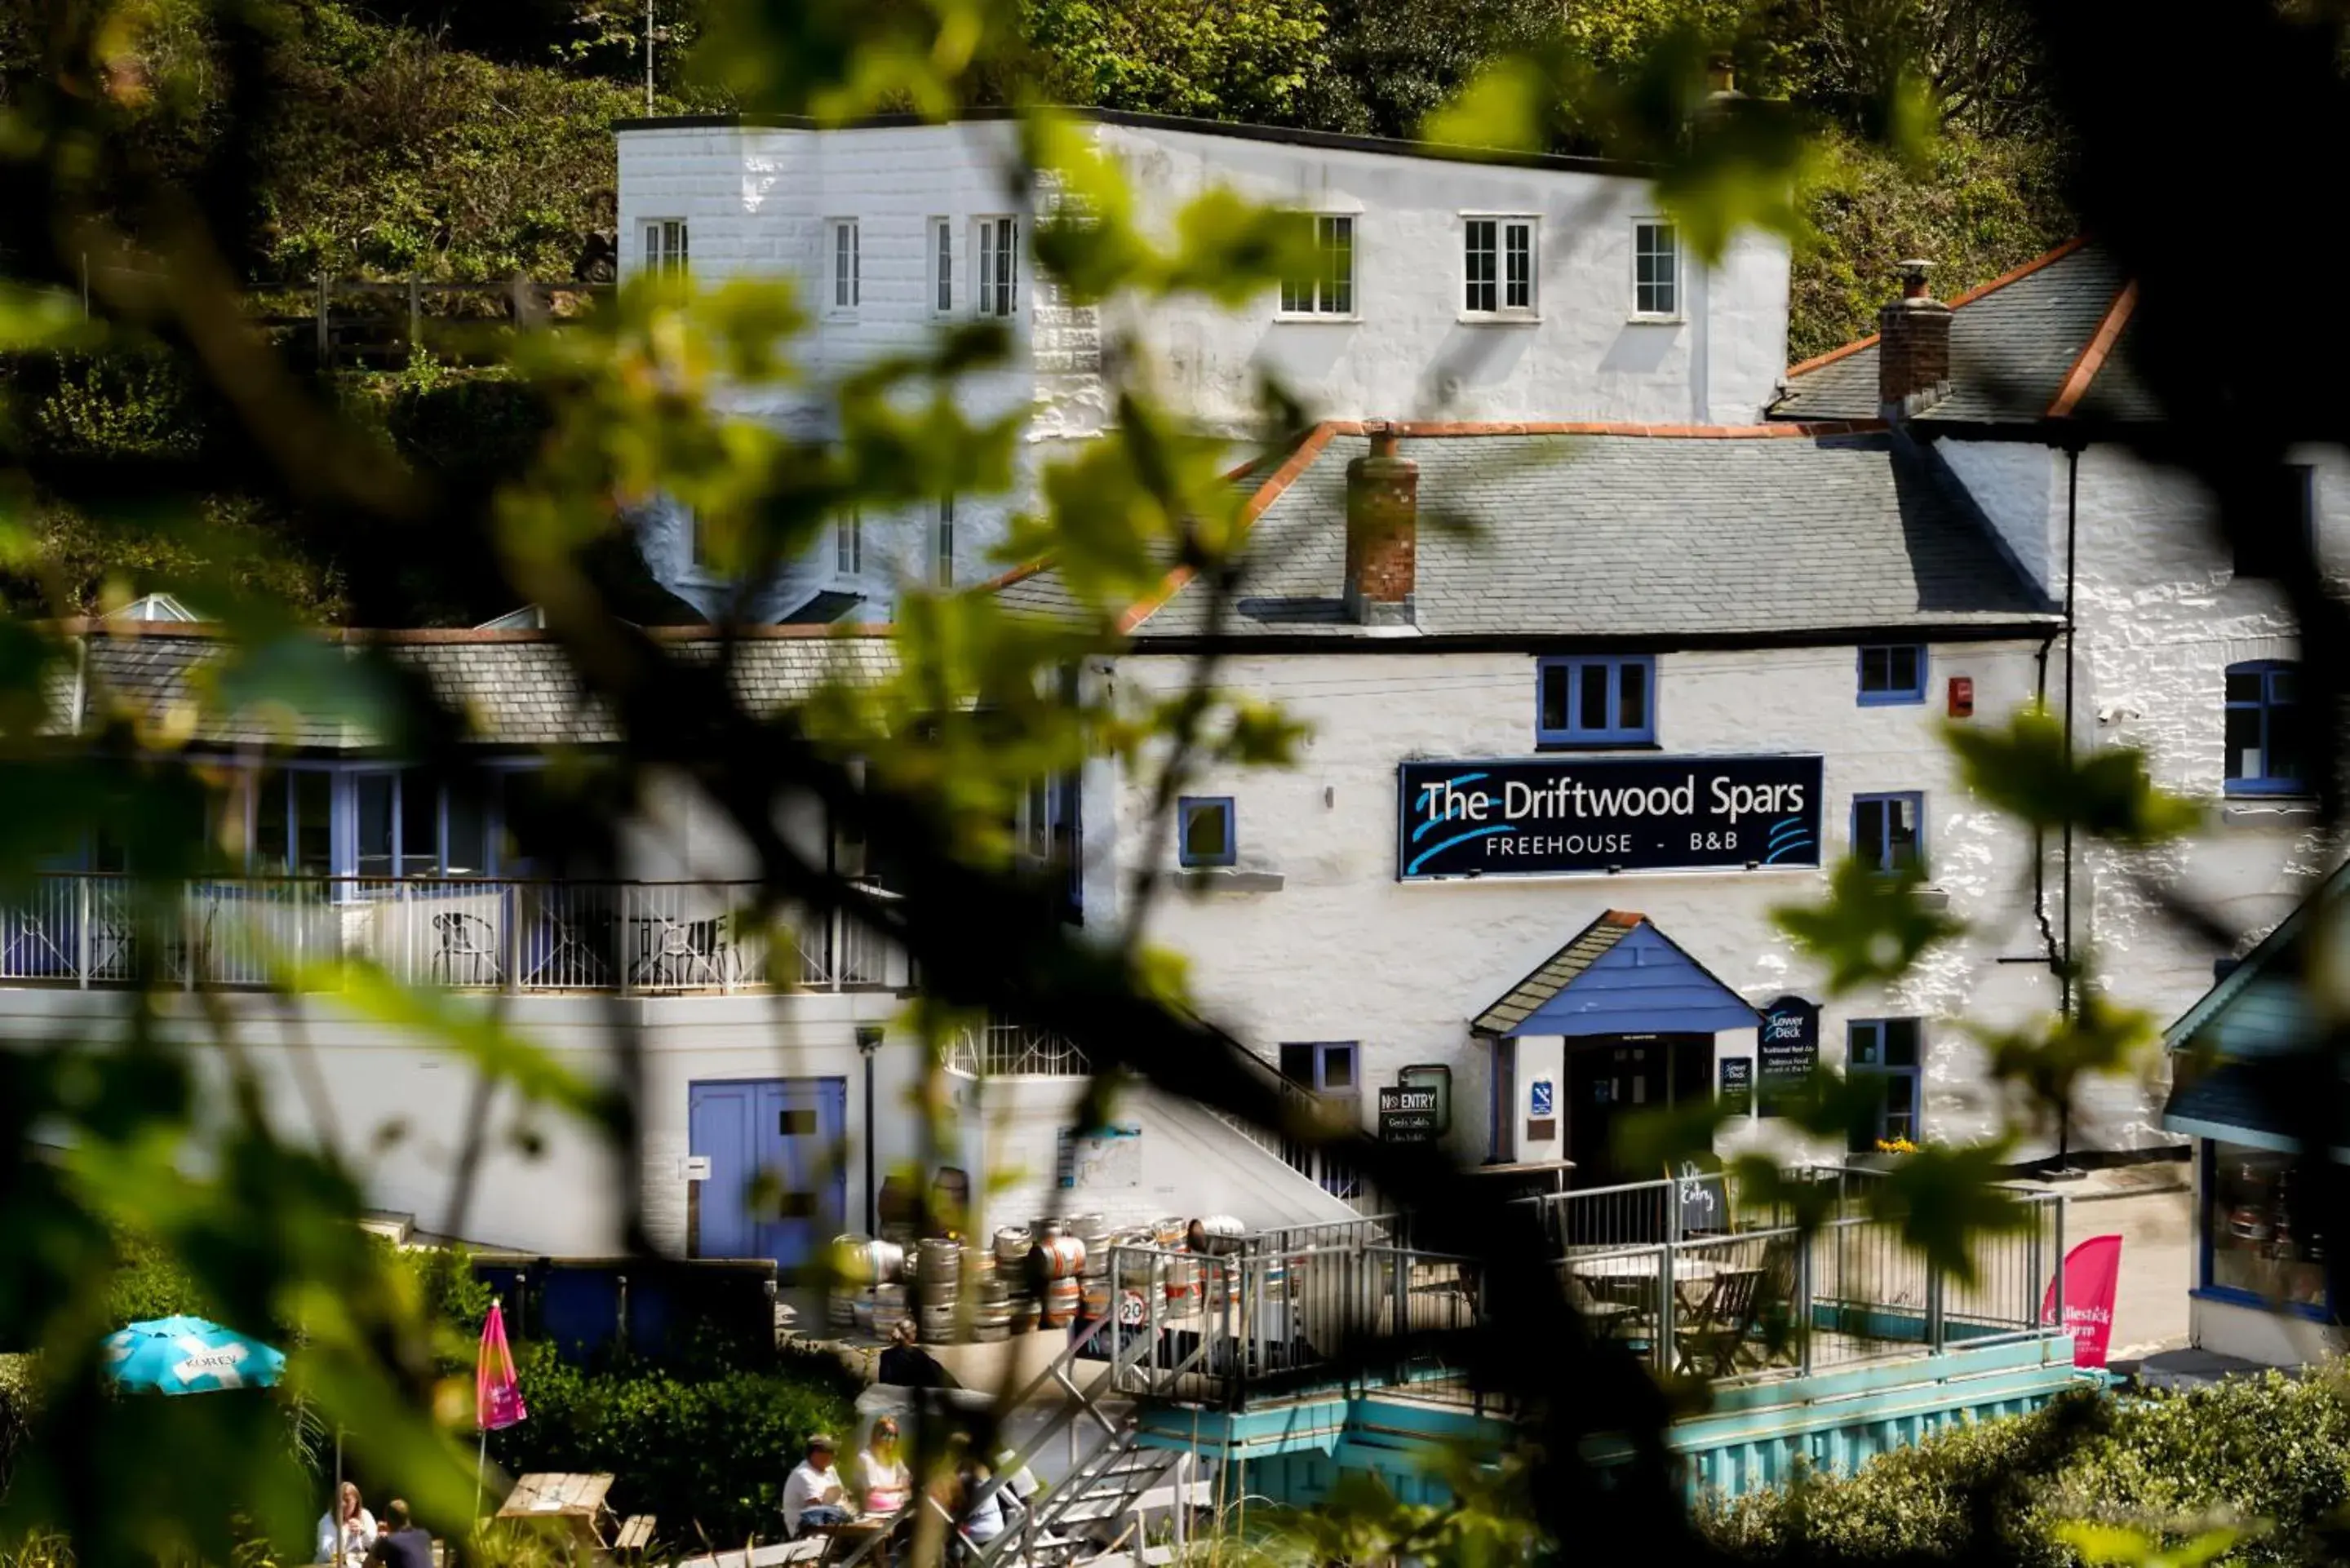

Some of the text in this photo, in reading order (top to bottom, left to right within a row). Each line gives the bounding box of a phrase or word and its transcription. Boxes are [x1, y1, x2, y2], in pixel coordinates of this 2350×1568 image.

[1421, 774, 1804, 825] The Driftwood Spars
[1486, 834, 1633, 856] FREEHOUSE
[1690, 831, 1738, 851] B&B
[1772, 1016, 1804, 1026] Lower
[1776, 1026, 1801, 1039] Deck
[1401, 1093, 1435, 1109] ENTRY
[1680, 1181, 1714, 1212] Entry
[1123, 1303, 1142, 1319] 20
